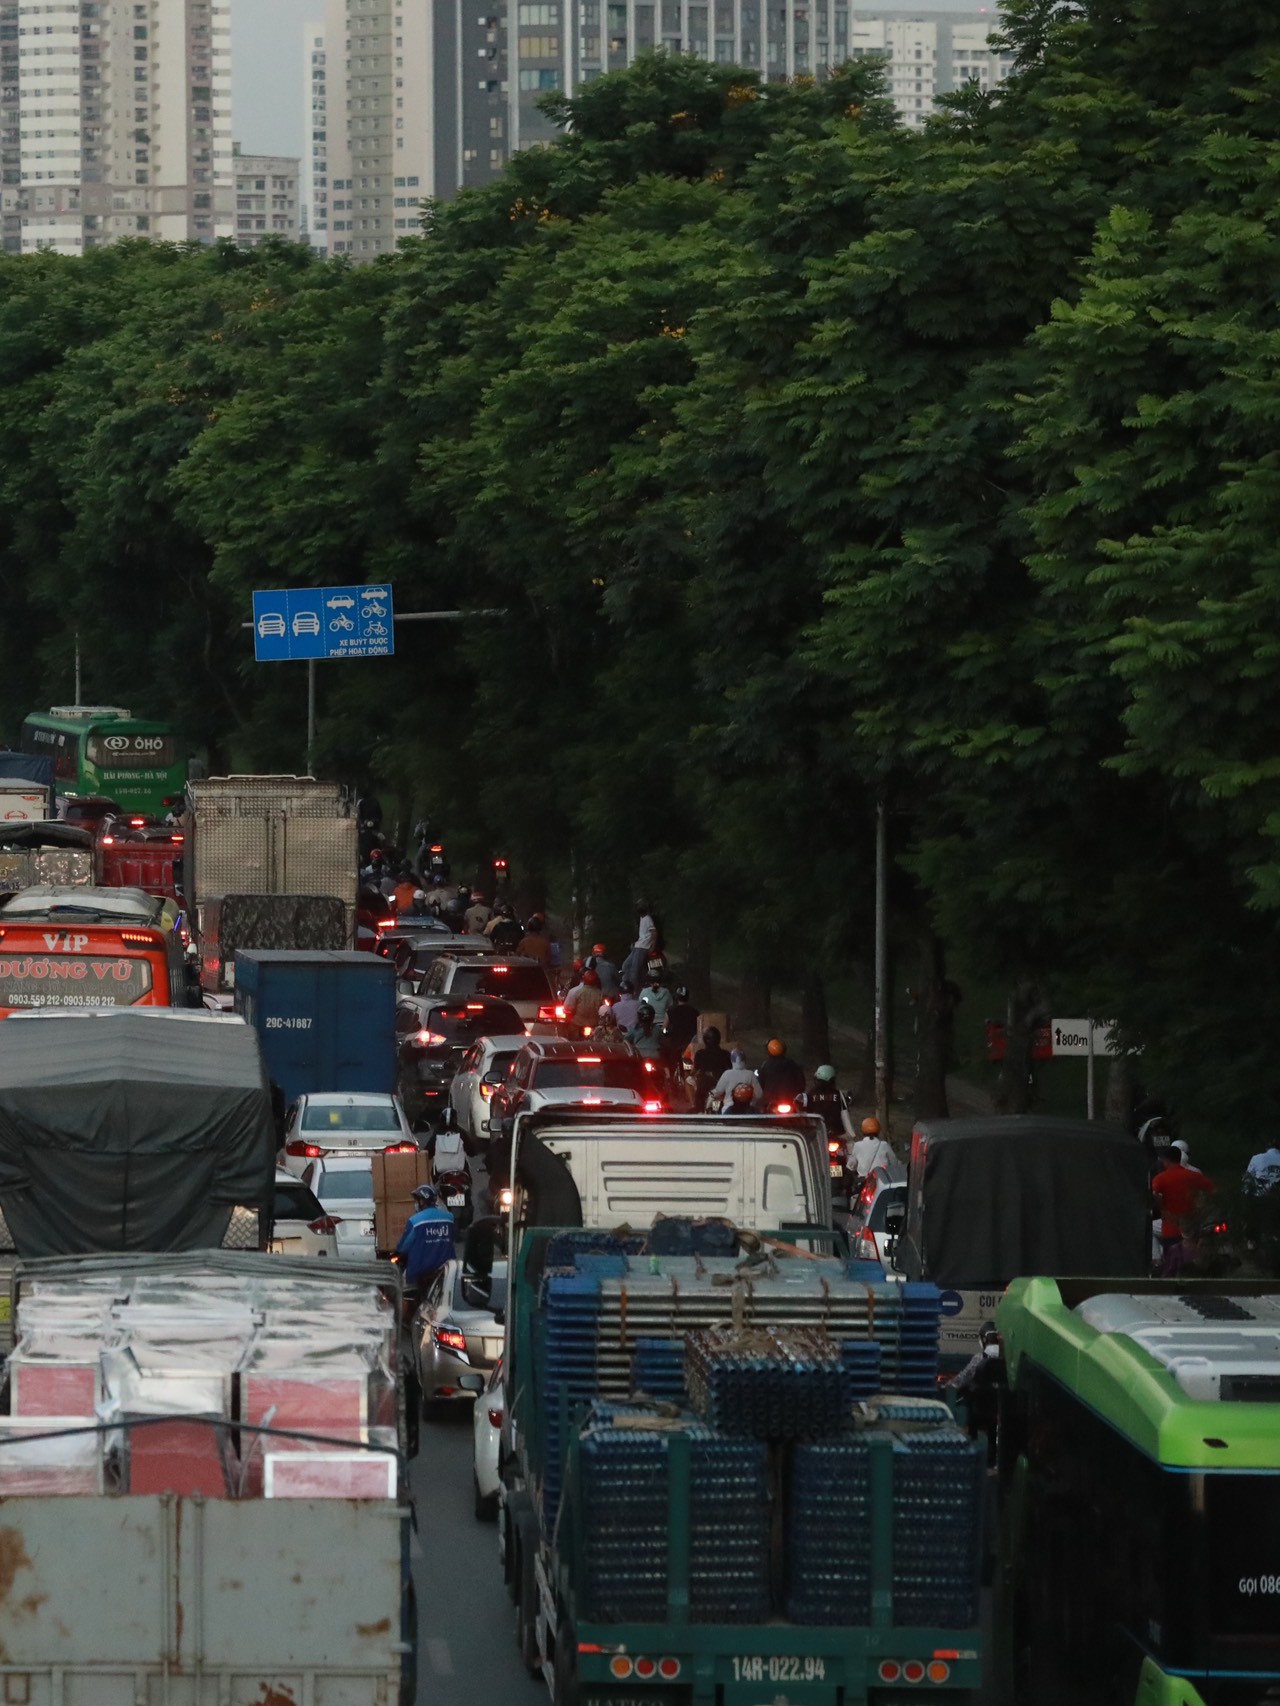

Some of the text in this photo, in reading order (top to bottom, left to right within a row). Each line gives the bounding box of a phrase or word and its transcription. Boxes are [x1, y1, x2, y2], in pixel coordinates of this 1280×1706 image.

[134, 736, 163, 750] ÔHÔ
[42, 933, 89, 952] VIP
[91, 959, 133, 980] VŨ
[266, 1017, 312, 1029] 29C-41687
[1061, 1034, 1088, 1046] 800m
[1238, 1578, 1258, 1597] GỌI
[732, 1656, 825, 1682] 14R-022.94
